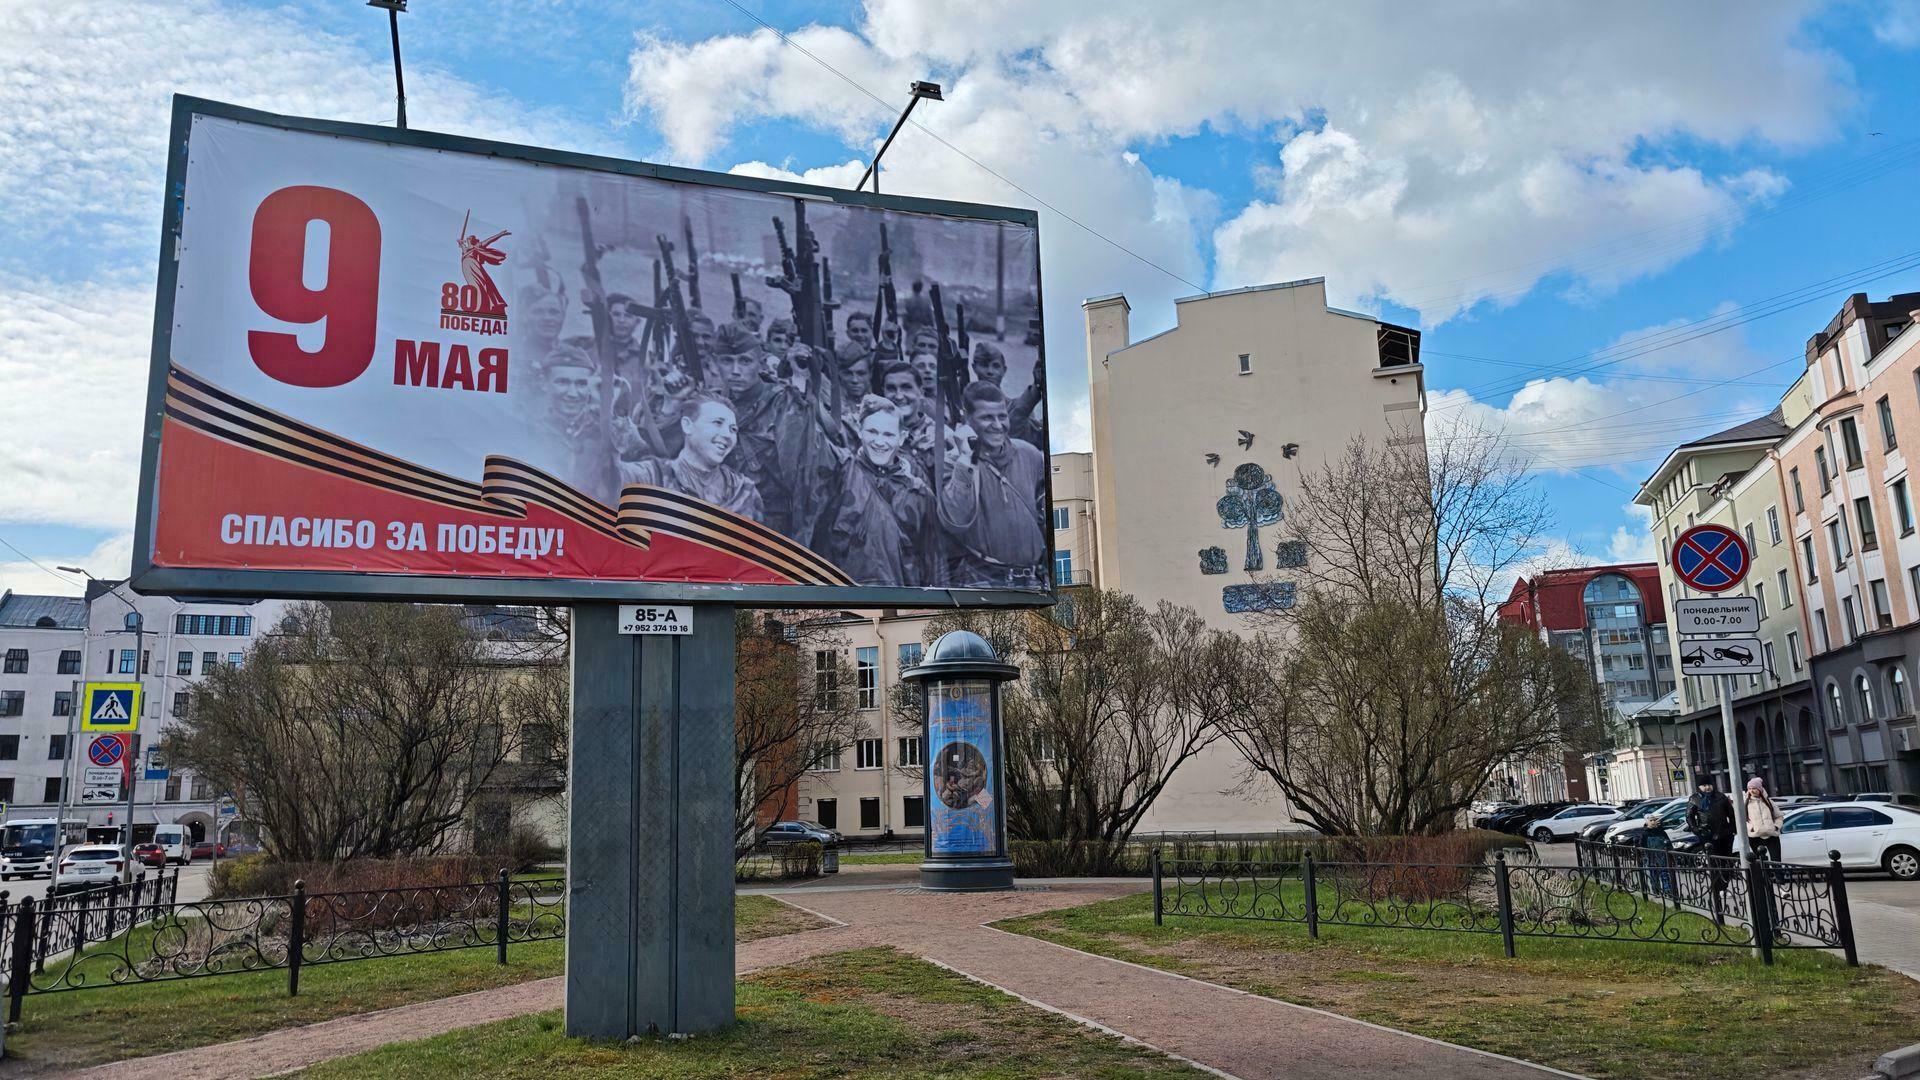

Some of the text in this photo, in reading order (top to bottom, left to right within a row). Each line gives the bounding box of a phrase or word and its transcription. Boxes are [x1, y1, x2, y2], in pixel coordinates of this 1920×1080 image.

[248, 185, 509, 394] 9 МАЯ
[441, 282, 478, 312] 80
[440, 315, 508, 336] ПОБЕДА!
[220, 513, 564, 560] СПАСИБО ЗА ПОБЕДУ!
[1683, 606, 1750, 614] понедельник
[1693, 615, 1742, 625] 0.00-7.00
[623, 624, 634, 632] +7
[635, 624, 651, 632] 952
[679, 625, 689, 633] 16
